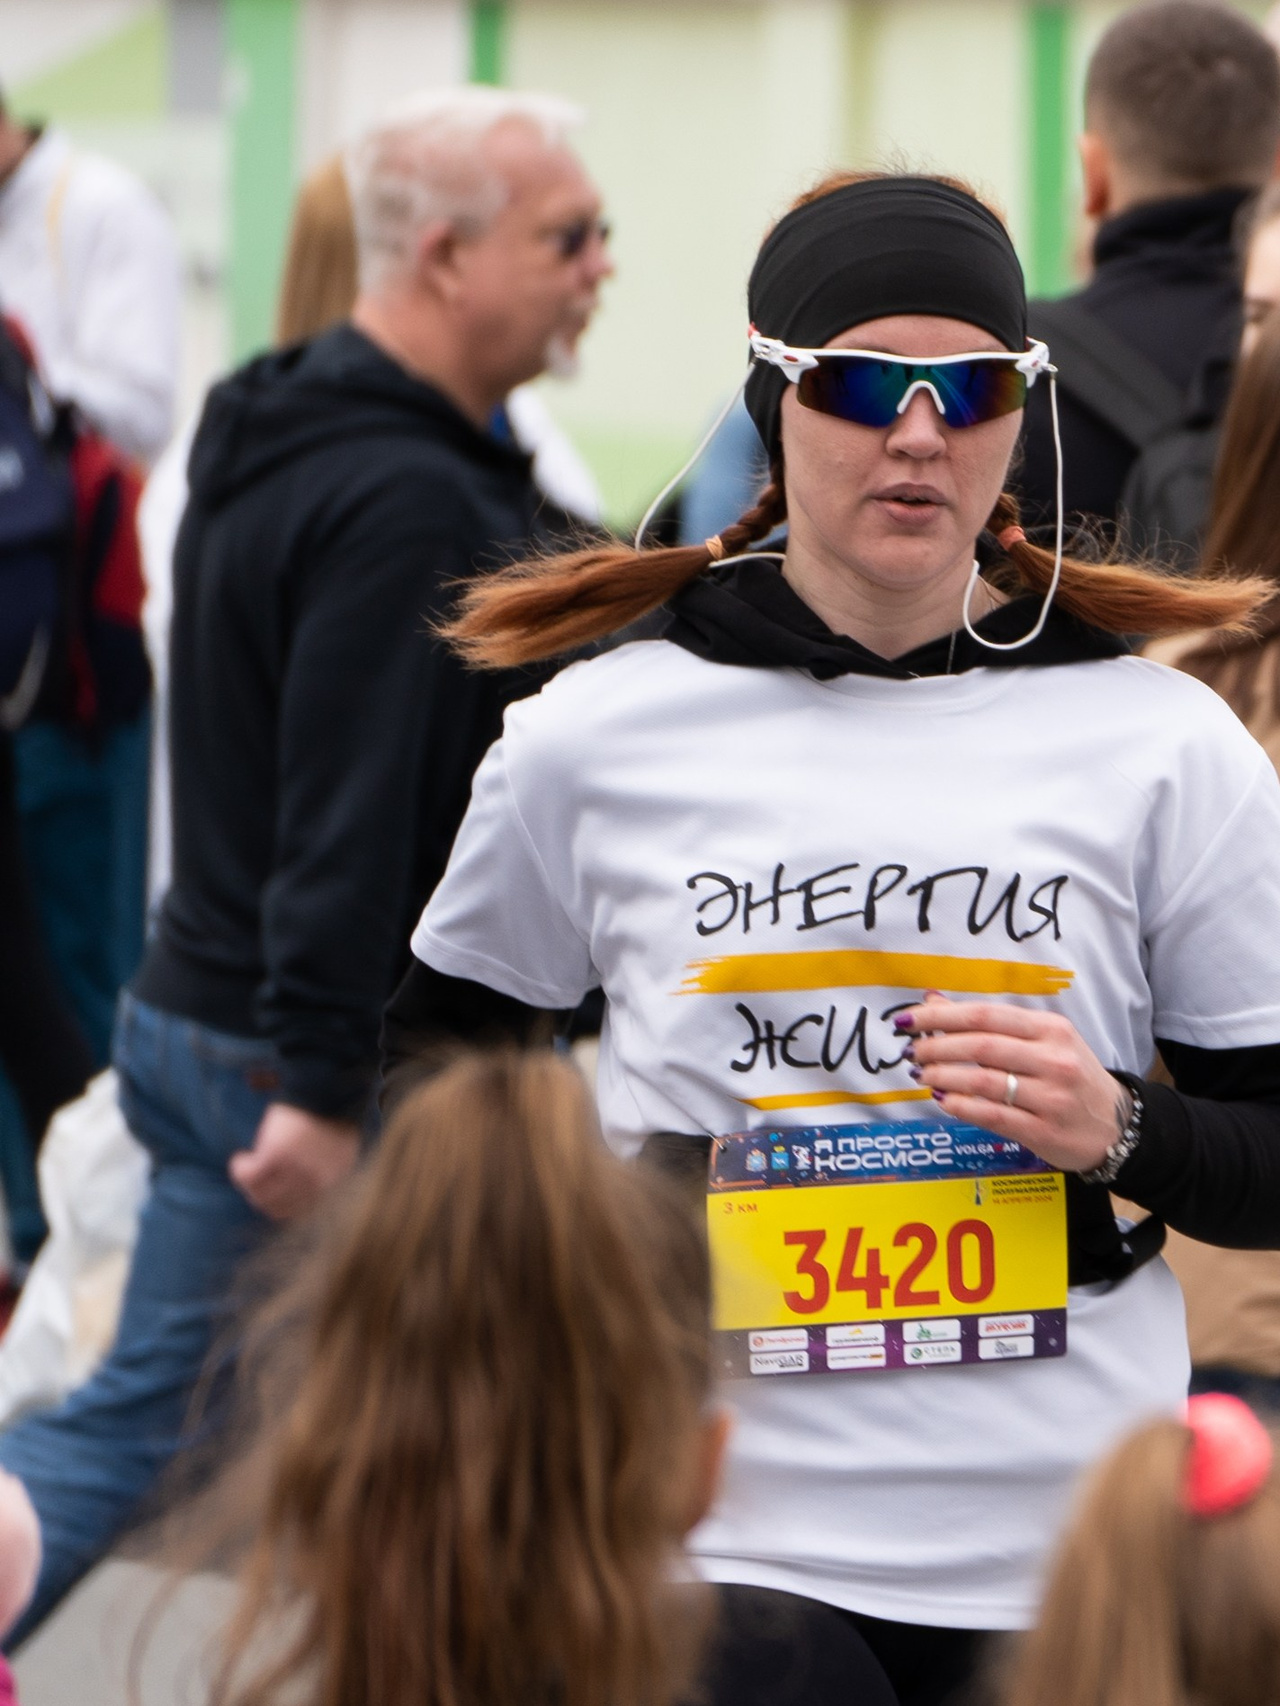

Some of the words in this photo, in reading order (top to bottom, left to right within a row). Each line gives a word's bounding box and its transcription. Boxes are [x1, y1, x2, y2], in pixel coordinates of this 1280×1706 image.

[687, 862, 1069, 942] ЭНЕРГИЯ
[814, 1139, 832, 1154] Я
[838, 1132, 953, 1151] ПРОСТО
[814, 1149, 954, 1172] КОСМОС
[724, 1202, 734, 1214] 3
[783, 1219, 996, 1314] 3420
